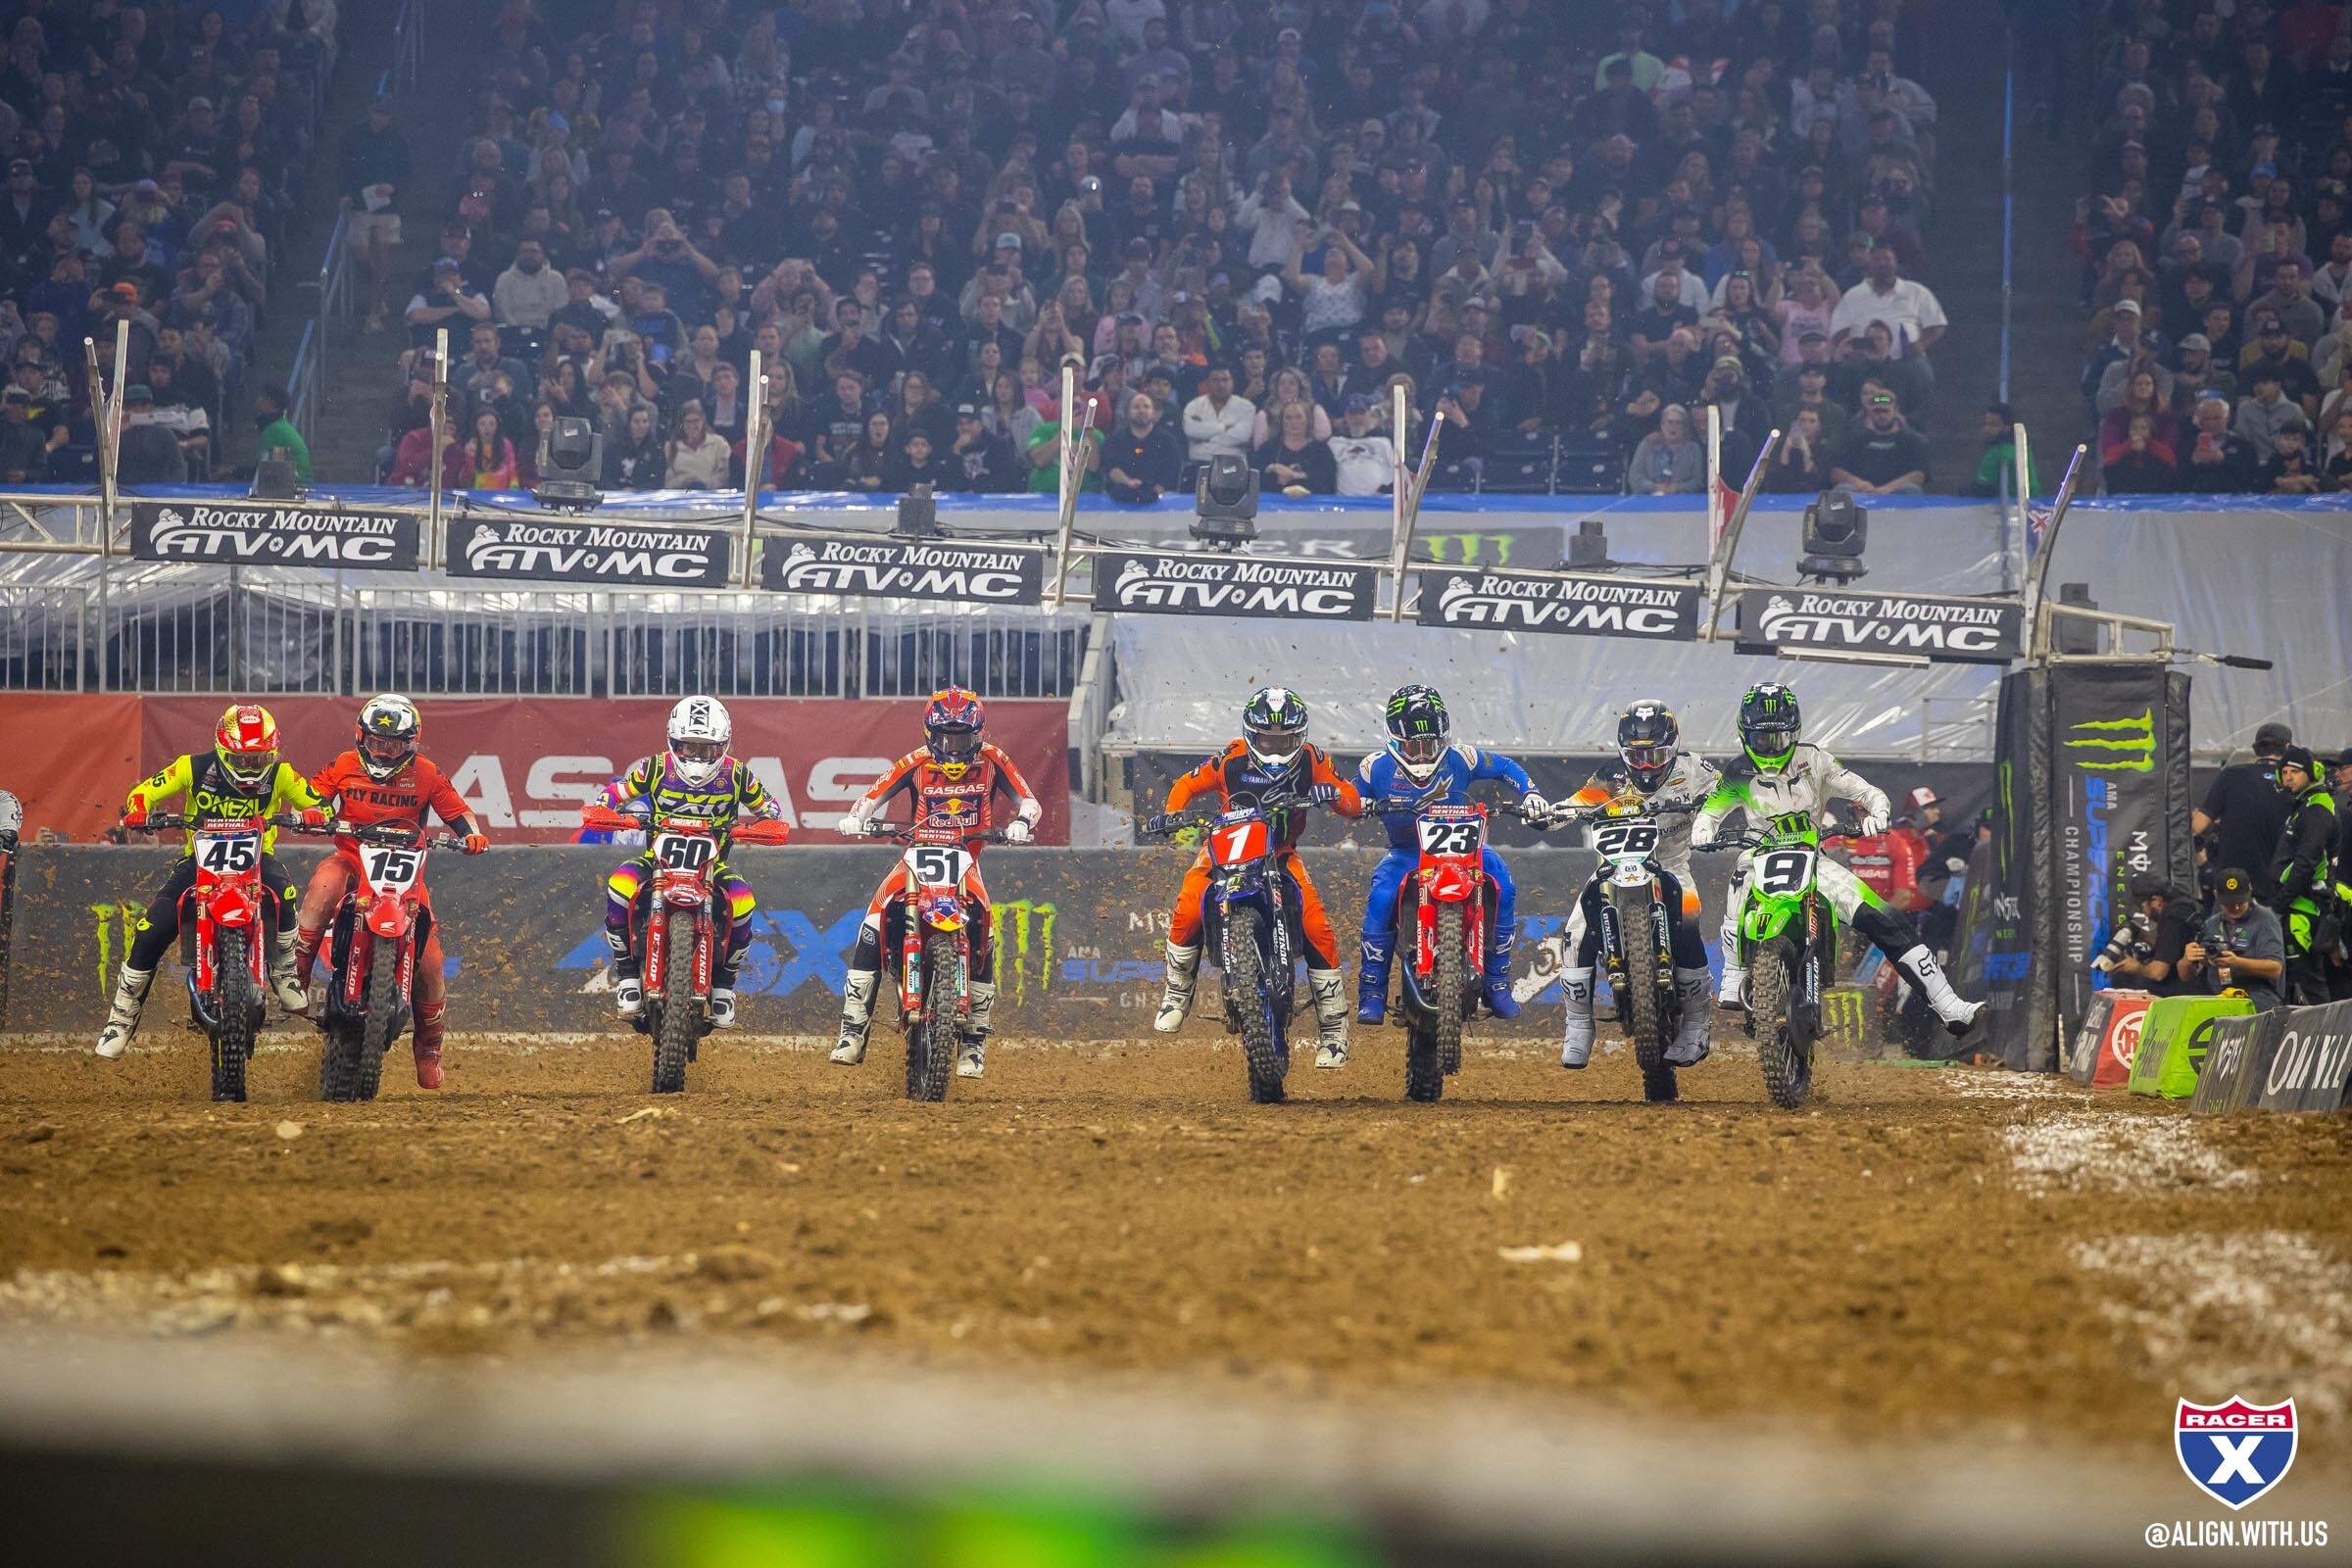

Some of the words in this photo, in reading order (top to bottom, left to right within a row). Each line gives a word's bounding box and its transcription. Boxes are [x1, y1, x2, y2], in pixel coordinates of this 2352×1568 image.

[190, 508, 268, 529] ROCKY
[269, 510, 398, 535] MOUNTAIN
[504, 522, 582, 546] ROCKY
[584, 527, 710, 552] MOUNTAIN
[820, 541, 898, 563] ROCKY
[902, 545, 1025, 570] MOUNTAIN
[1152, 559, 1228, 580] ROCKY
[1231, 563, 1356, 587] MOUNTAIN
[1478, 574, 1554, 598] ROCKY
[1559, 580, 1681, 608] MOUNTAIN
[1797, 594, 1875, 617] ROCKY
[1879, 599, 2003, 625] MOUNTAIN
[345, 787, 368, 803] FLY
[370, 791, 419, 808] RACING
[2106, 781, 2118, 810] AMA
[929, 815, 955, 827] Red
[955, 812, 978, 826] Bull
[661, 837, 712, 870] 60
[1226, 824, 1252, 862] 1
[1427, 824, 1479, 856] 23
[1595, 827, 1658, 857] 28
[204, 841, 255, 872] 45
[370, 851, 416, 882] 15
[915, 850, 959, 883] 51
[1763, 852, 1808, 894] 9
[2064, 825, 2083, 963] CHAMPIONSHIP
[1277, 918, 1289, 966] DUNLOP
[402, 951, 411, 1003] DUNLOP
